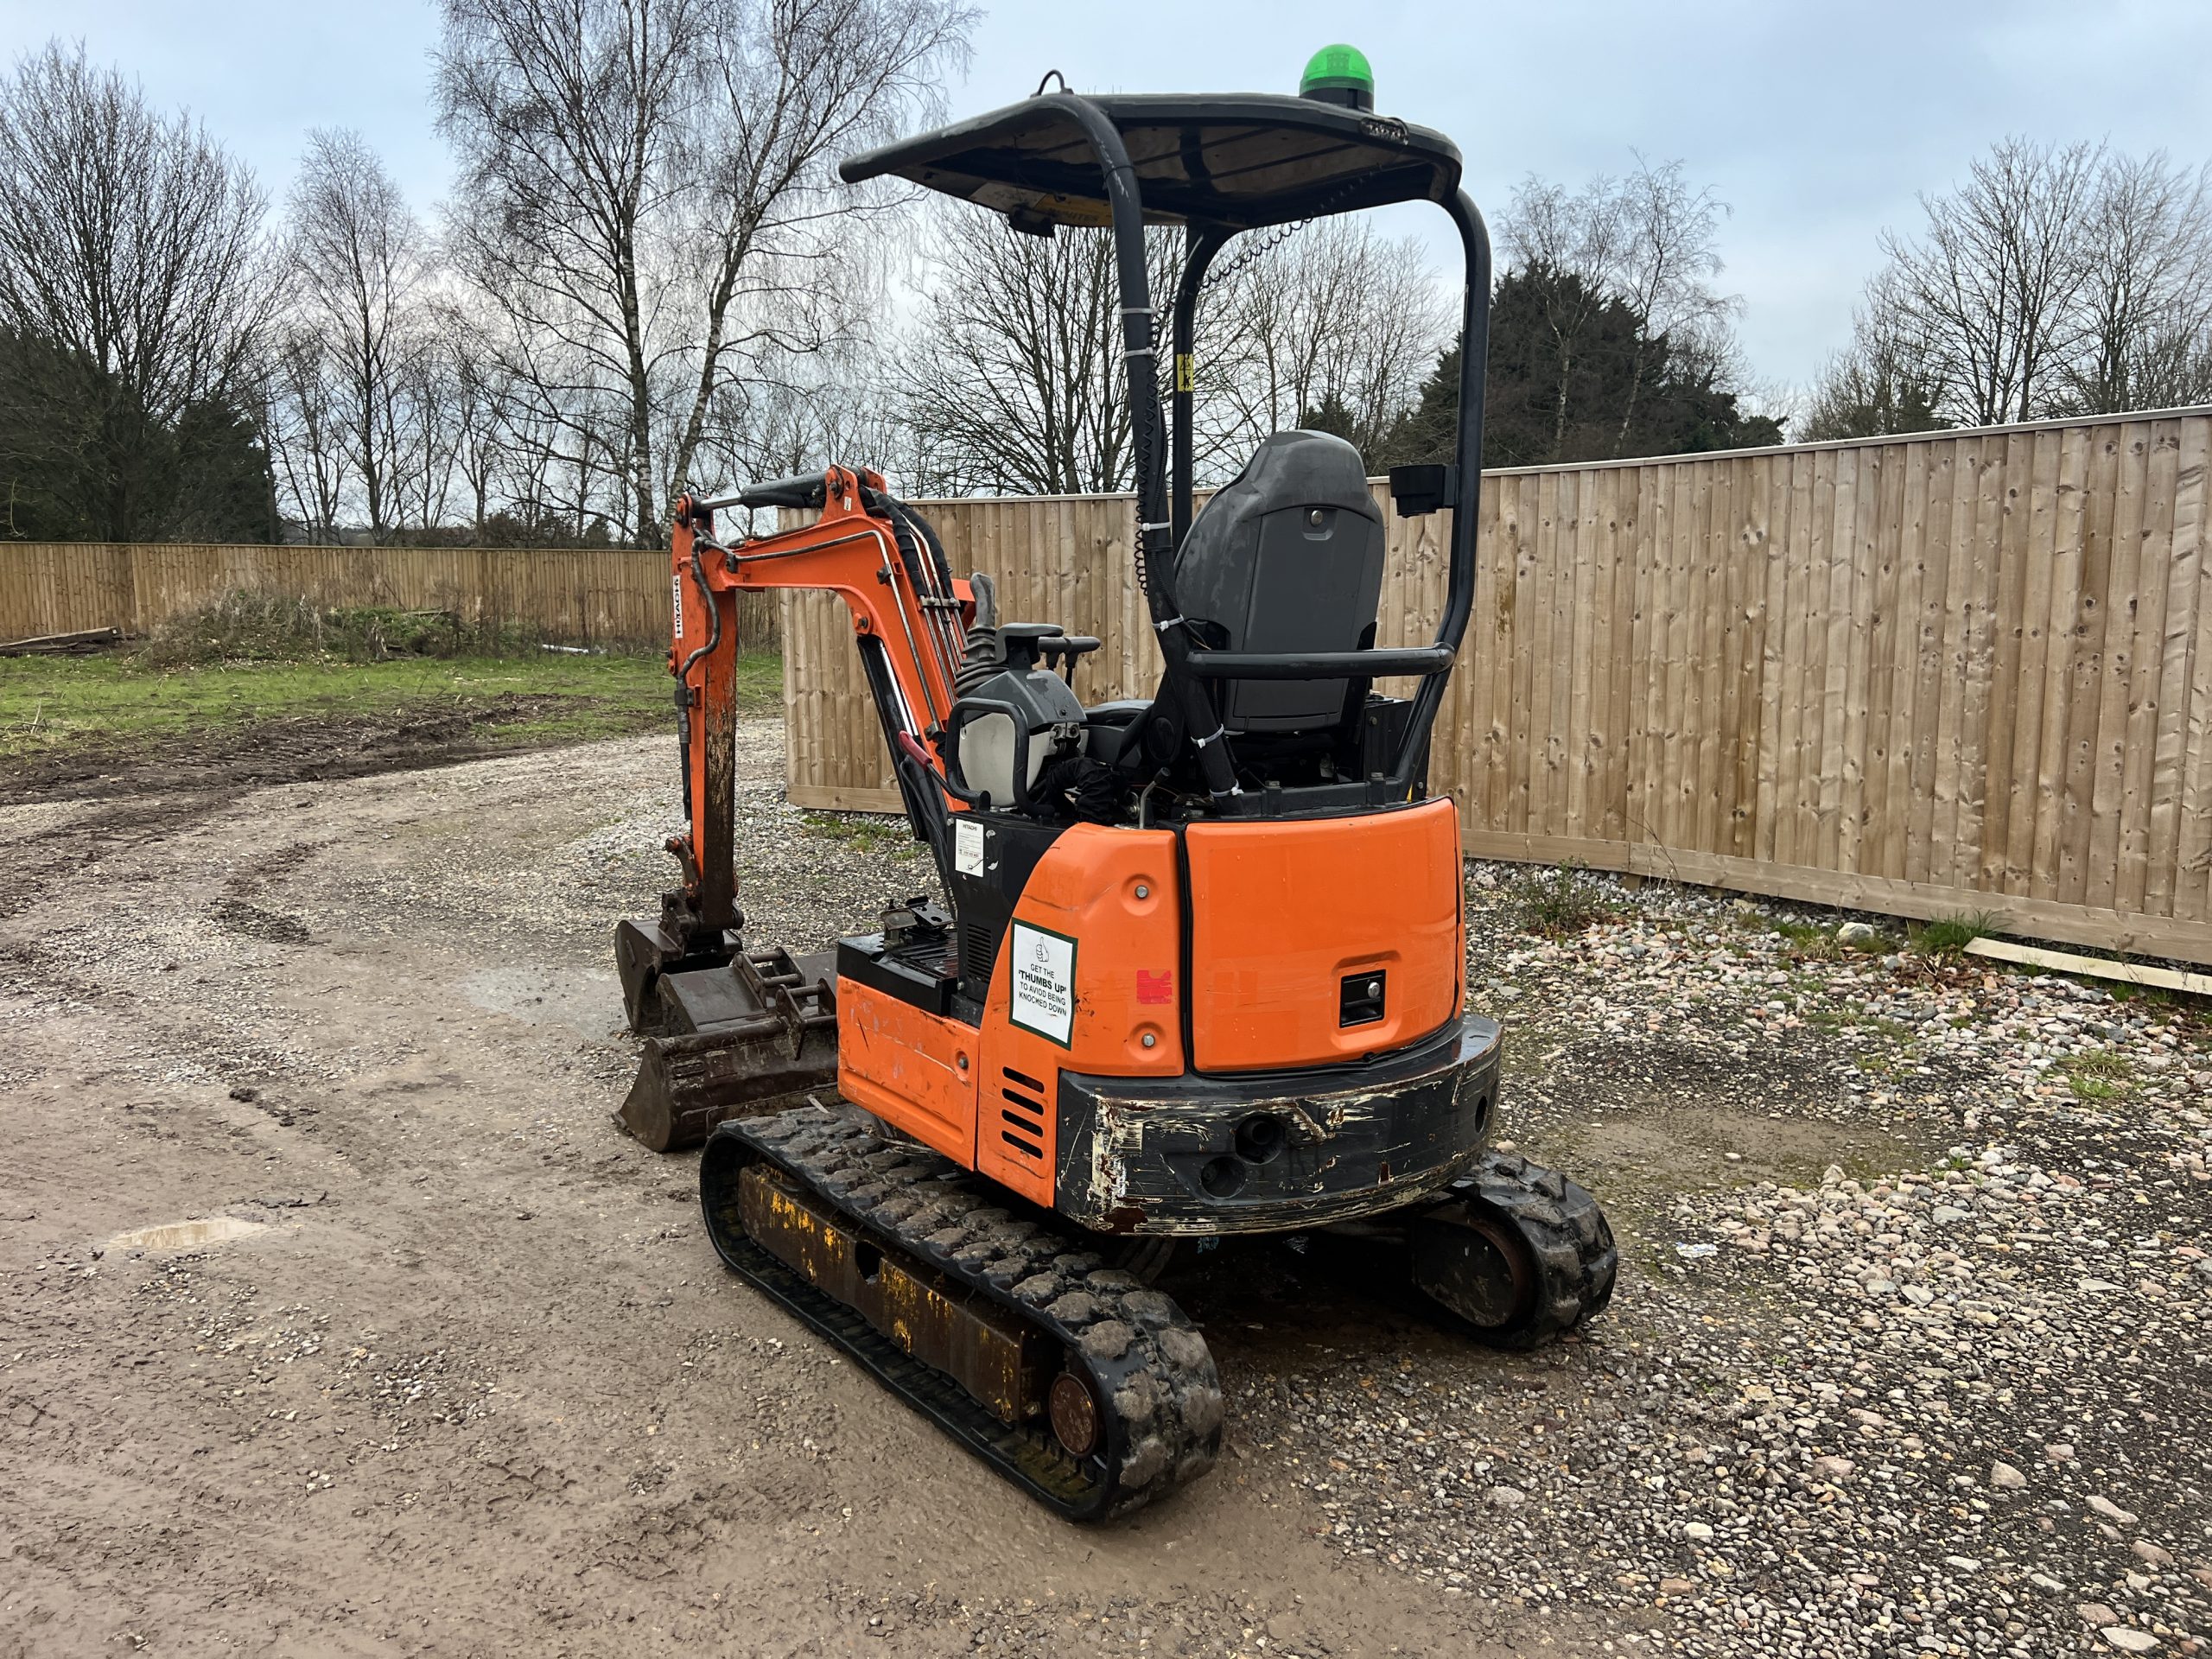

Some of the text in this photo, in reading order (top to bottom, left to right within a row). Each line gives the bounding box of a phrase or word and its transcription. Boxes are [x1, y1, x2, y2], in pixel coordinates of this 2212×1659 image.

[1031, 963, 1055, 979] GET THE
[1019, 991, 1067, 1016] KNOCKED DOWN
[1020, 982, 1066, 1005] TO AVIOD BEING
